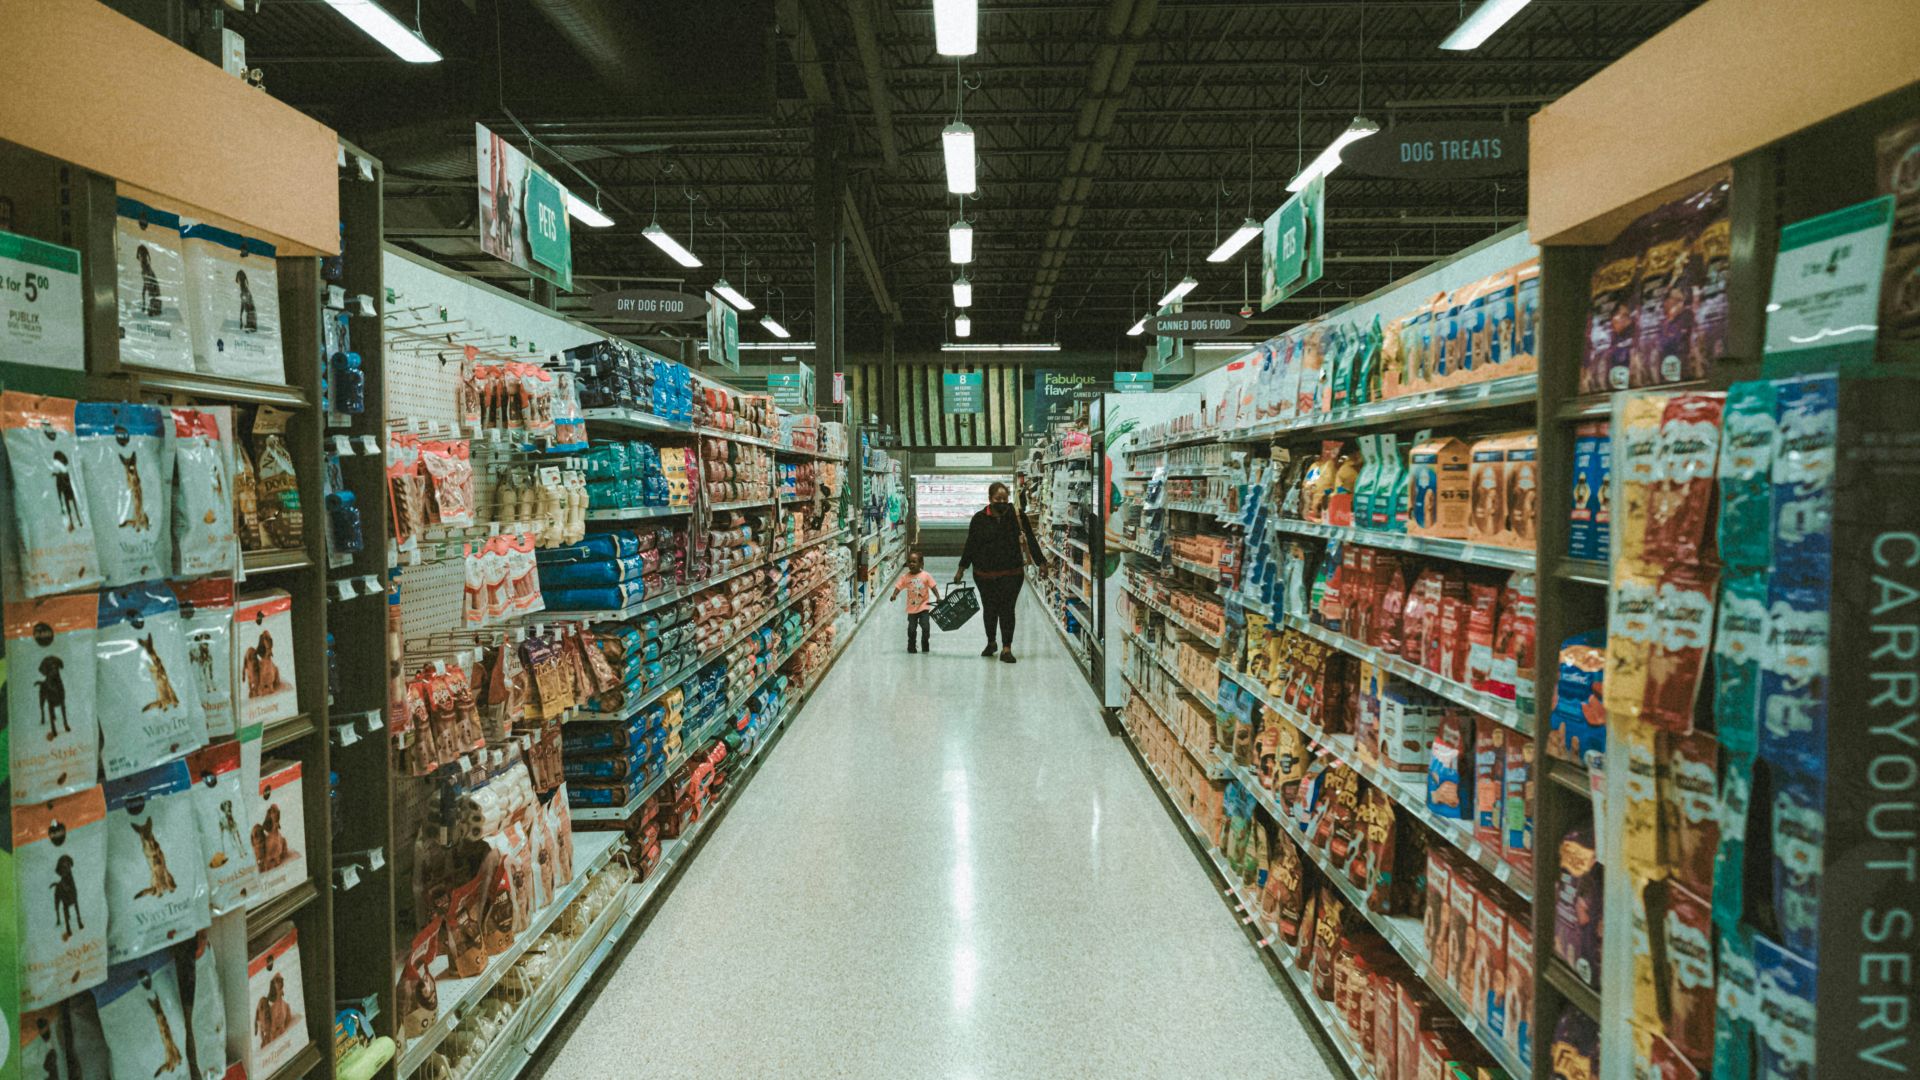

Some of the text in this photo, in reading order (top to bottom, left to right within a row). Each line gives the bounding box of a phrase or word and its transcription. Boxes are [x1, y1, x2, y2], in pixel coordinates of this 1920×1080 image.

[1400, 138, 1502, 162] DOG TREATS
[538, 201, 557, 242] PETS
[6, 276, 21, 292] for
[617, 298, 684, 313] DRY DOG FOOD
[9, 310, 39, 323] PUBLIX
[1157, 319, 1232, 331] CANNED DOG FOOD
[959, 374, 967, 384] 8
[1045, 372, 1096, 385] Fabulous
[1130, 373, 1137, 382] 7
[1864, 532, 1920, 881] CARRYOUT
[1858, 908, 1913, 1072] SERV
